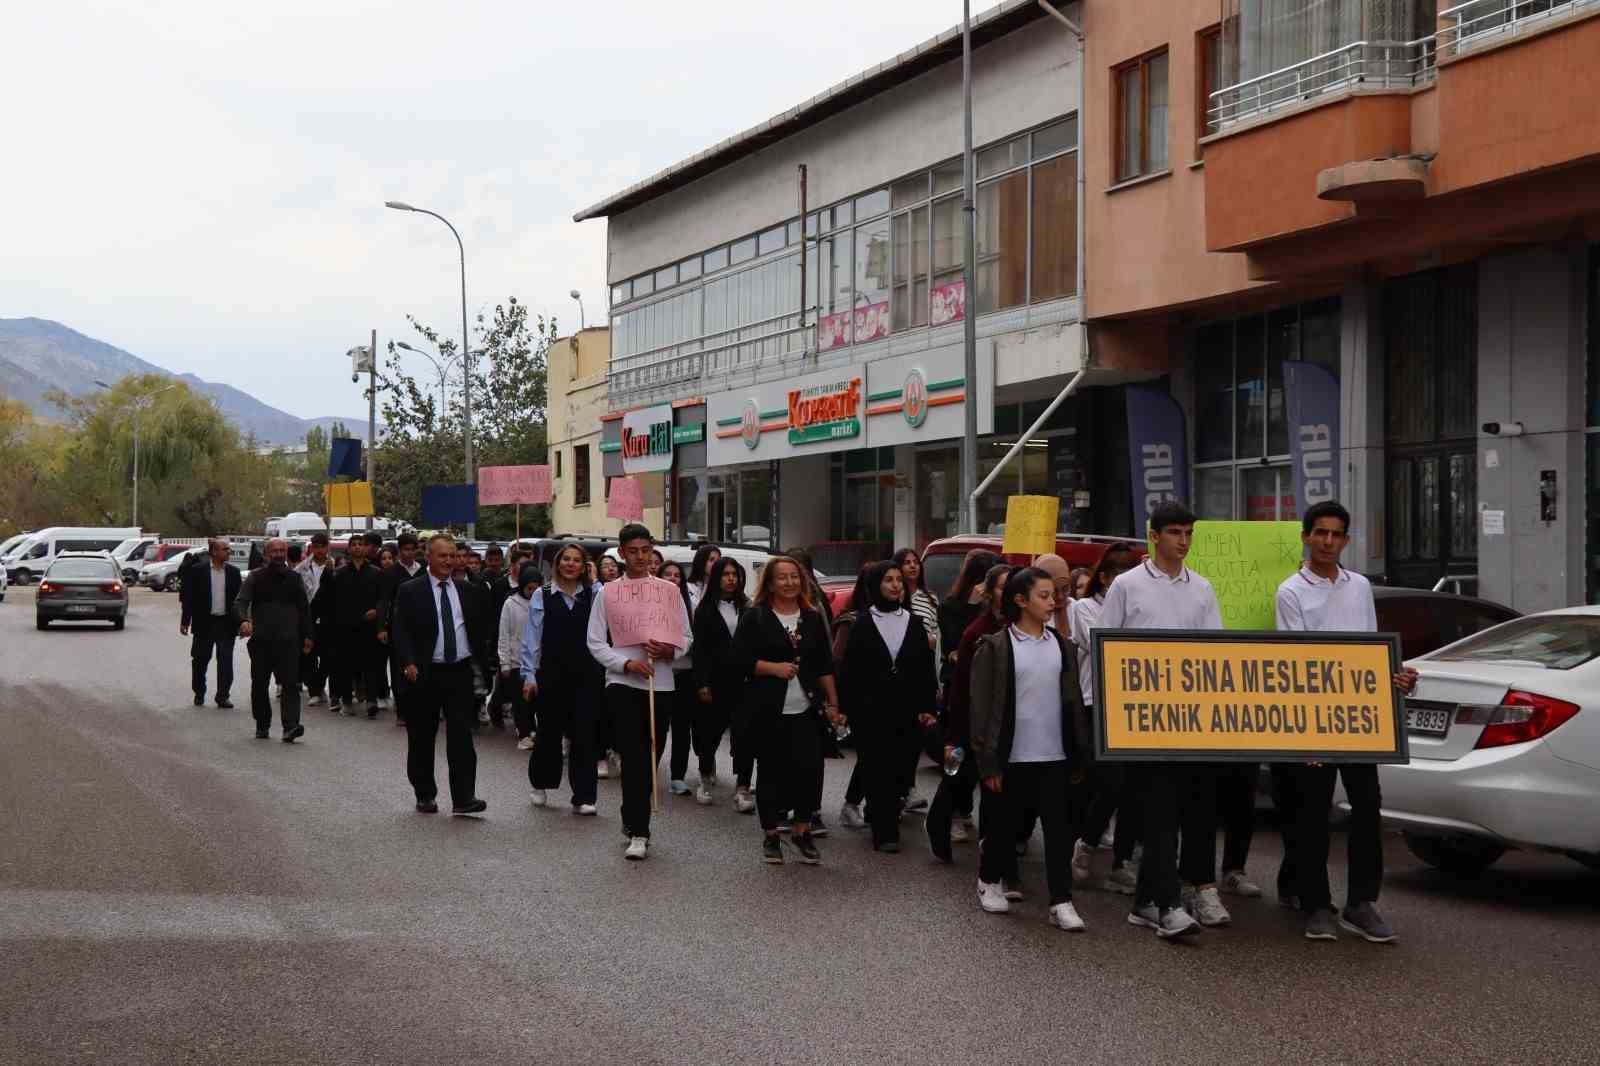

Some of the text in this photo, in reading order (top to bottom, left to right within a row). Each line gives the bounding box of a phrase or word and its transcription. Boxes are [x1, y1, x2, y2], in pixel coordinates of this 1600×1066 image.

[1350, 668, 1377, 694] ve
[1210, 704, 1307, 733] ANADOLU
[1416, 711, 1446, 729] 8839
